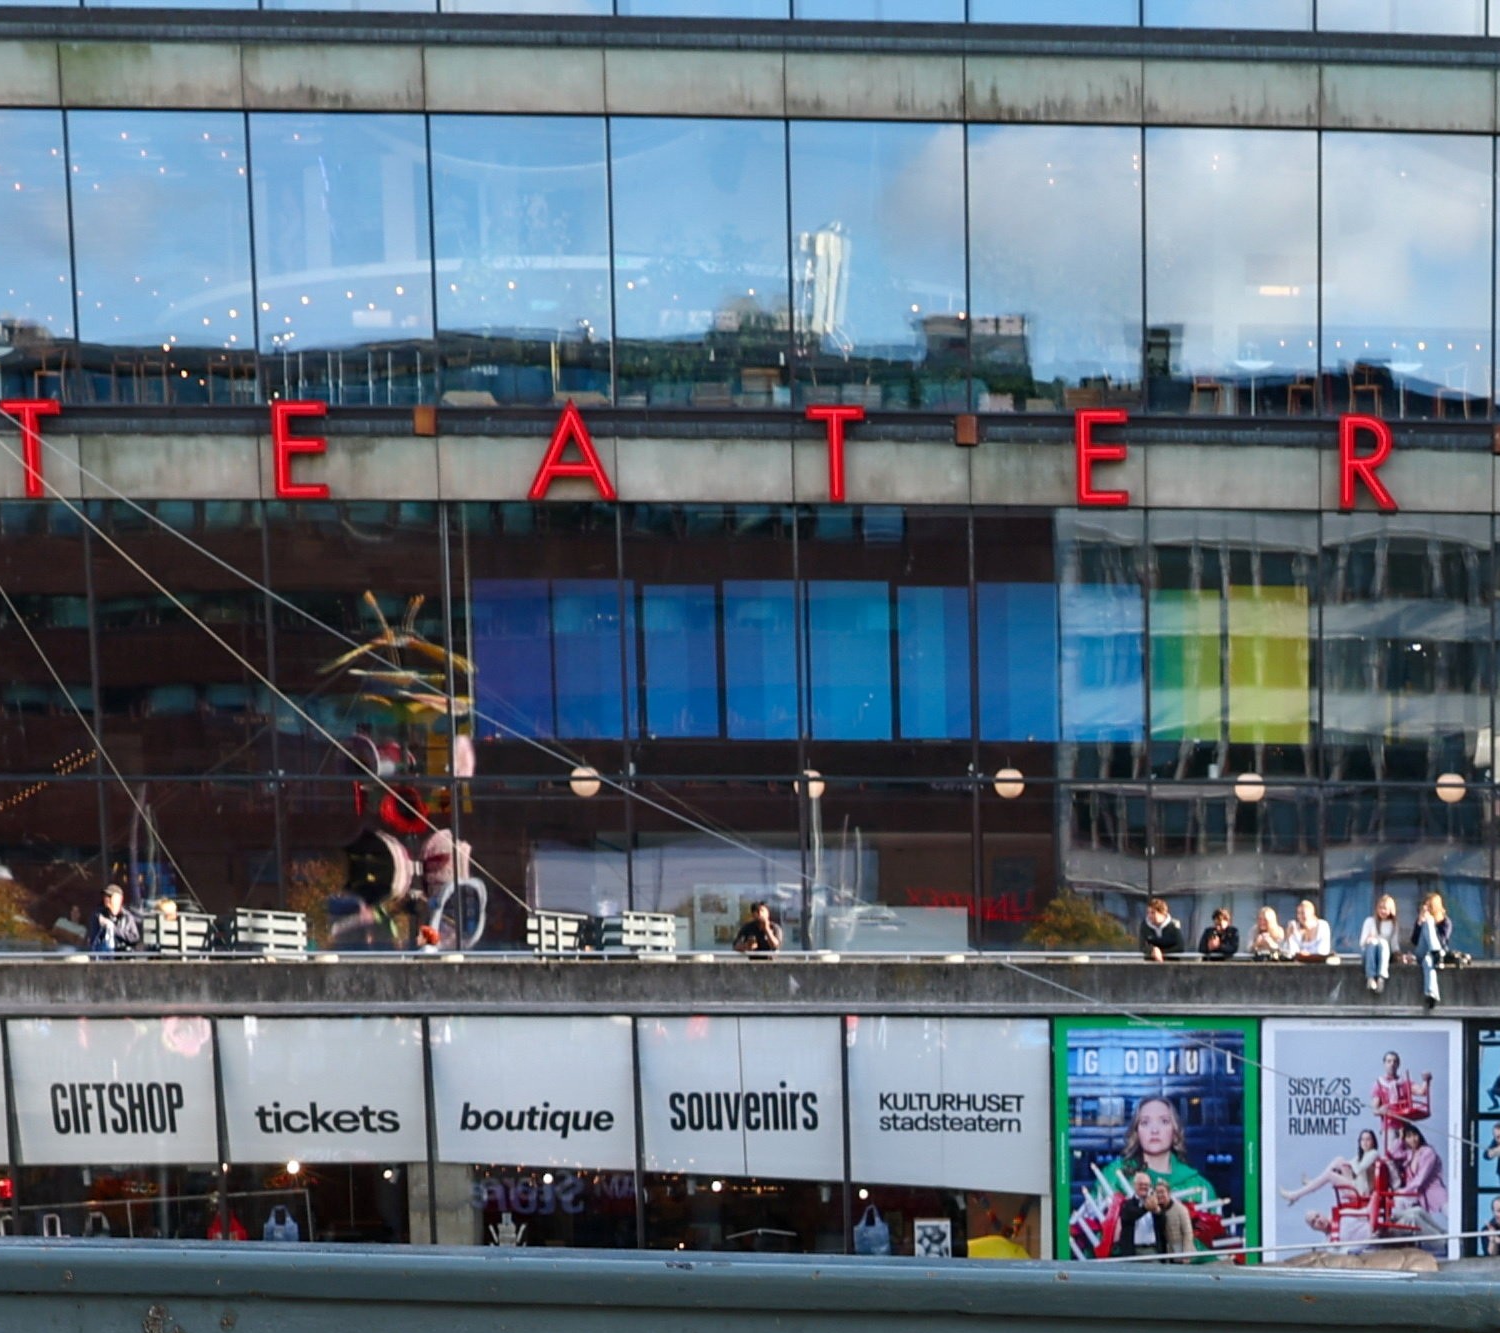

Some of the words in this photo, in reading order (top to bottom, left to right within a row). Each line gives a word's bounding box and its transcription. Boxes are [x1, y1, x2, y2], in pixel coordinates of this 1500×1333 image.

[51, 1082, 184, 1135] GIFTSHOP
[255, 1101, 401, 1135] tickets
[460, 1101, 615, 1138] boutique
[669, 1081, 819, 1132] souvenirs
[879, 1092, 1025, 1113] KULTURHUSET
[879, 1111, 1023, 1134] stadsteatern
[1288, 1117, 1348, 1136] RUMMET
